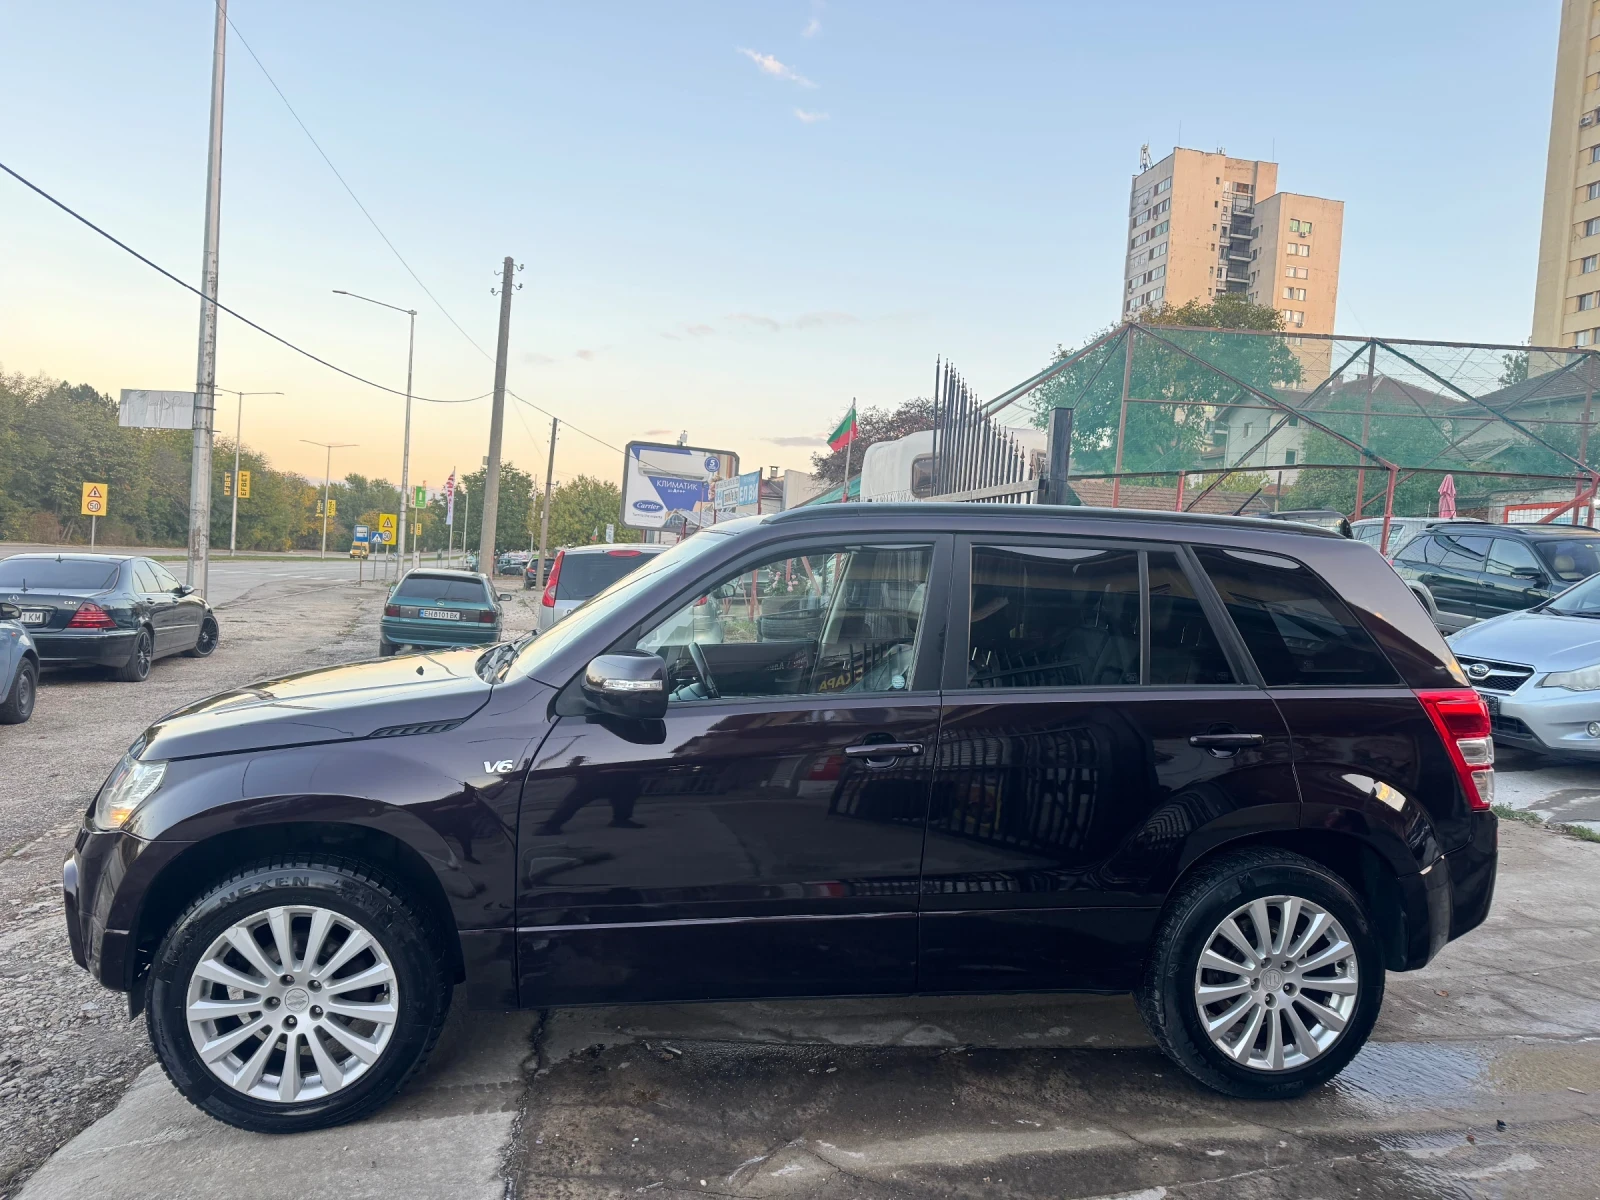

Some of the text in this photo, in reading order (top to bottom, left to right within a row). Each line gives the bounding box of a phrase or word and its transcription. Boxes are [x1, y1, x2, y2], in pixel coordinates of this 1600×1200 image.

[240, 472, 248, 496] EFBET
[656, 479, 698, 491] КЛИМАТИК
[89, 502, 99, 510] 50
[636, 502, 661, 510] Carrier
[383, 532, 391, 540] 50
[483, 759, 514, 774] V6
[219, 876, 310, 908] NEXEN
